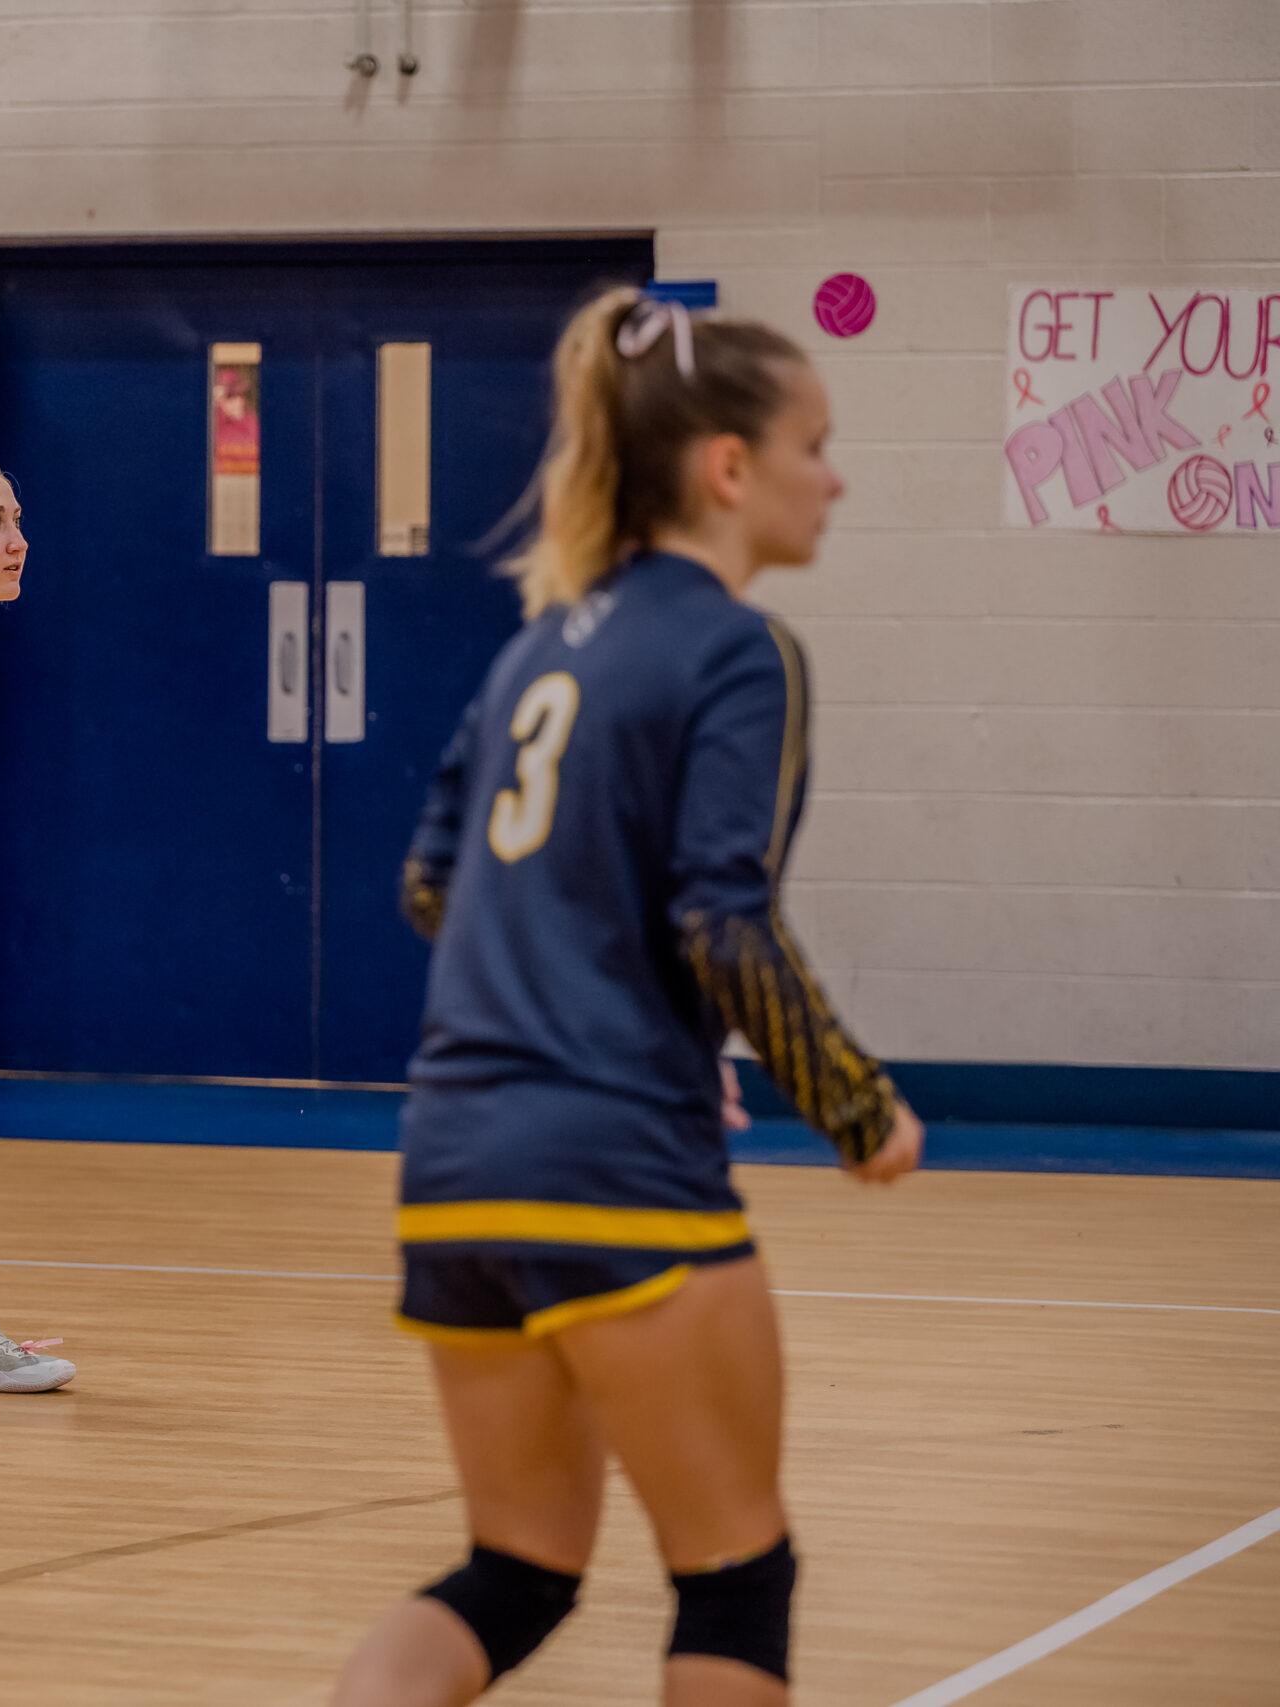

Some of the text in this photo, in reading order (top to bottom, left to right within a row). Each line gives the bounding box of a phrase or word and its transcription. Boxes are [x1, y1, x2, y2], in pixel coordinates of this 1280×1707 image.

[1019, 290, 1114, 362] GET
[1005, 367, 1202, 527] PINK
[488, 669, 580, 864] 3
